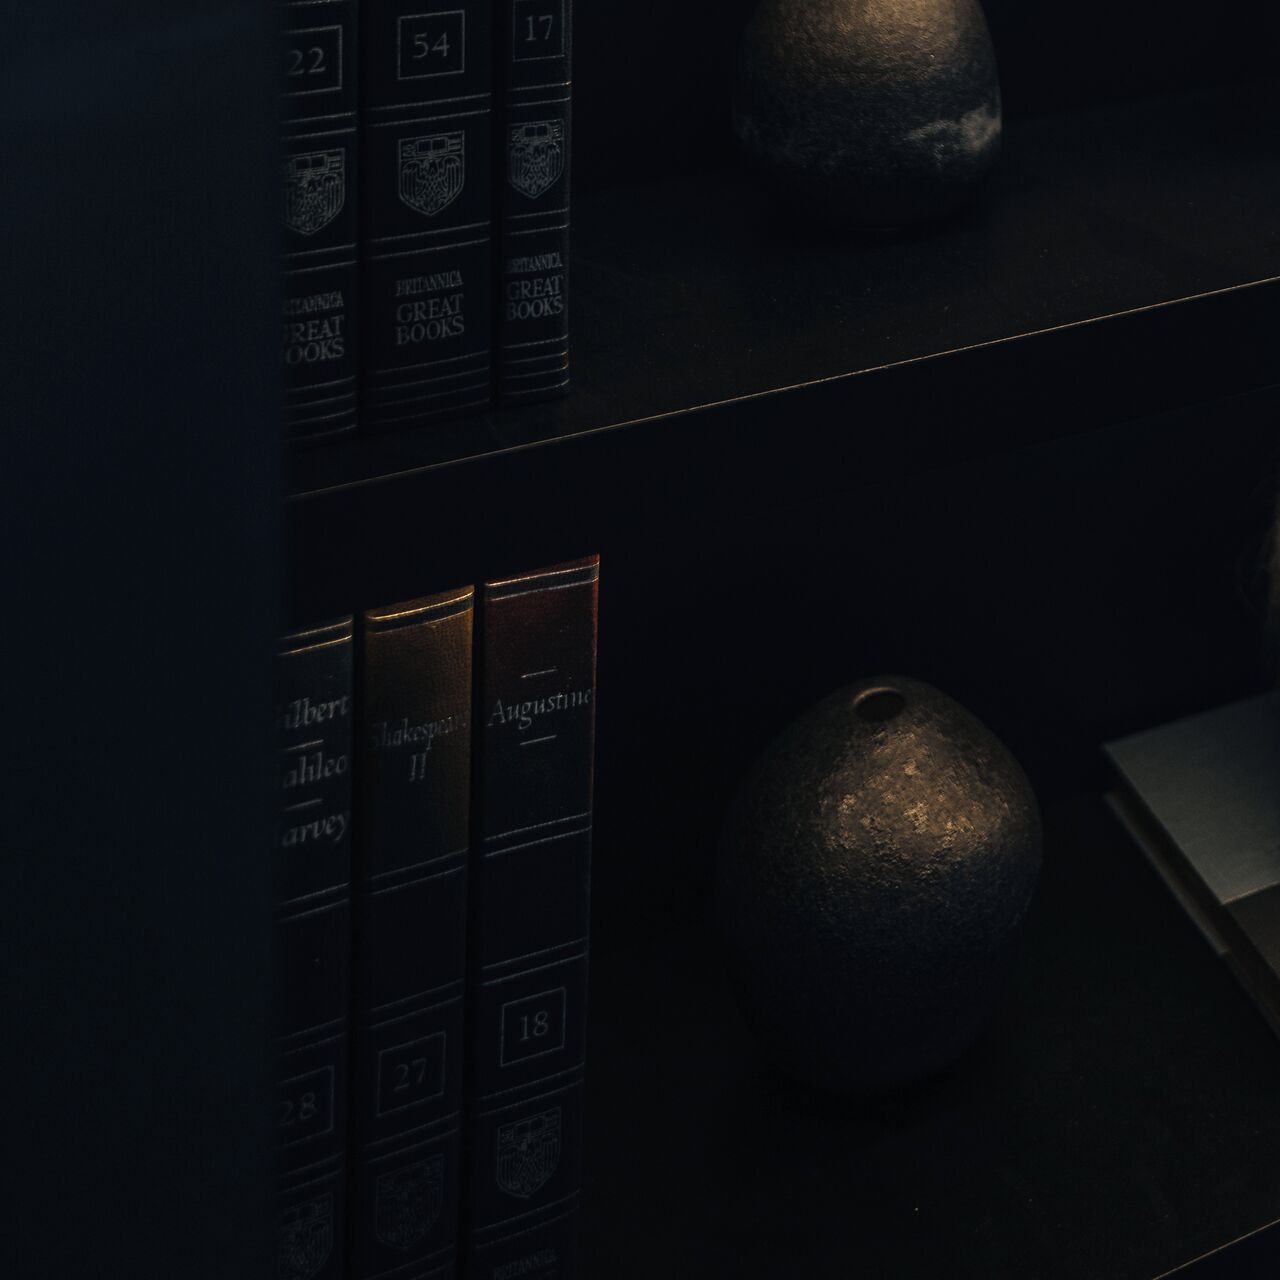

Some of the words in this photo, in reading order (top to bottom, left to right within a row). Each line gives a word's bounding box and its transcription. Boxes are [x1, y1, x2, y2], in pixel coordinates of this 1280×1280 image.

[524, 14, 554, 42] 17
[411, 31, 451, 59] 54
[287, 47, 327, 76] 22
[396, 268, 464, 296] BRITANNICA
[505, 274, 564, 301] GREAT
[395, 293, 465, 324] GREAT
[505, 295, 564, 321] BOOKS
[286, 315, 345, 344] REAT
[395, 315, 465, 346] BOOKS
[284, 338, 345, 365] OOKS
[485, 688, 594, 730] Augustine
[518, 1009, 550, 1042] 18
[392, 1057, 428, 1093] 27
